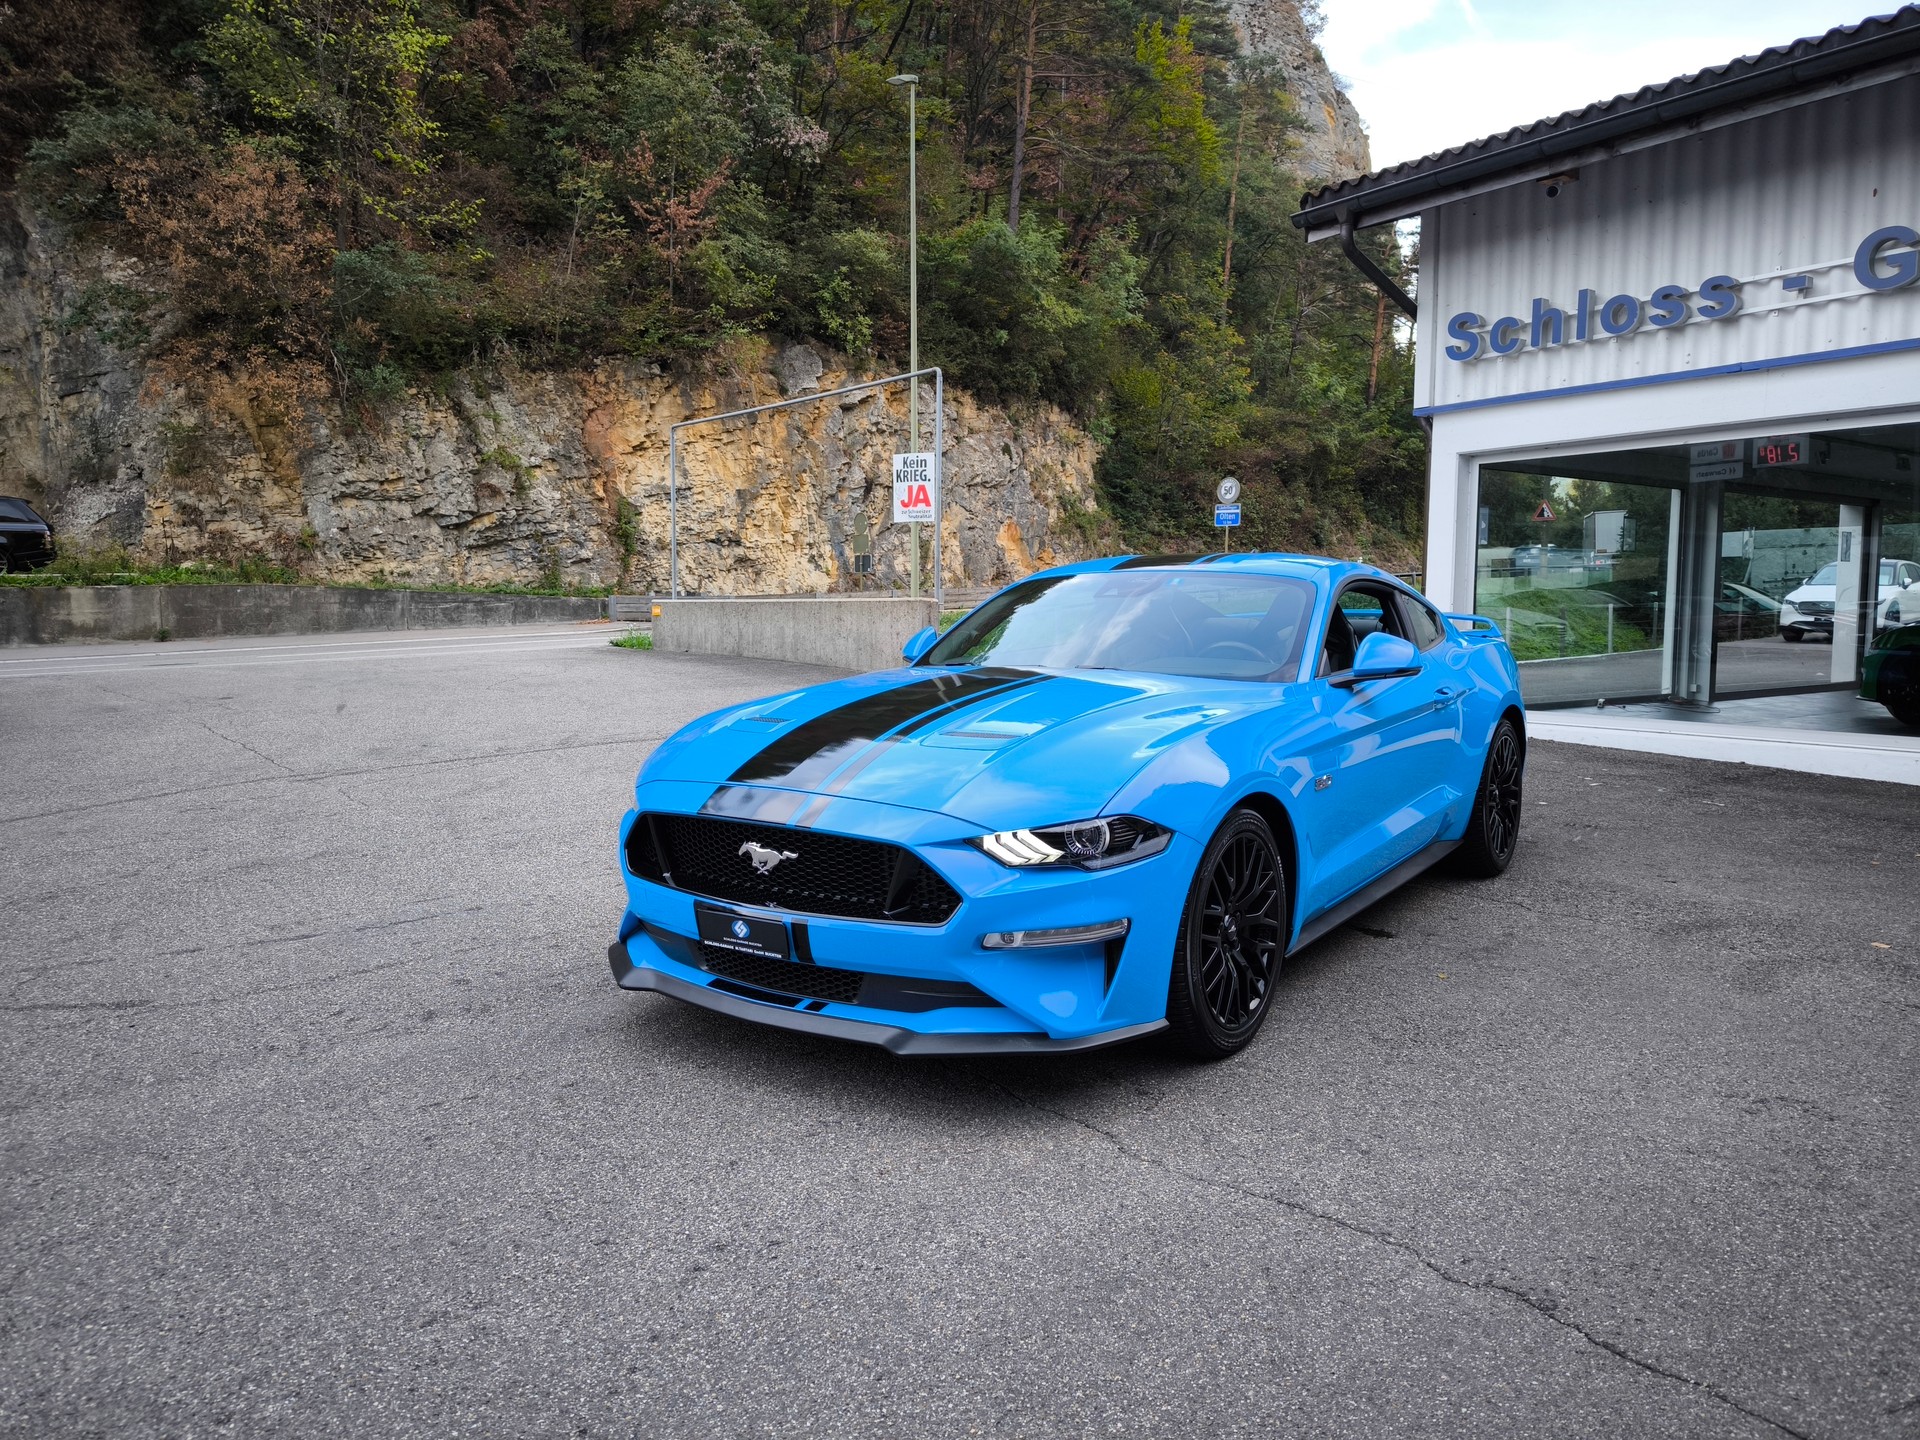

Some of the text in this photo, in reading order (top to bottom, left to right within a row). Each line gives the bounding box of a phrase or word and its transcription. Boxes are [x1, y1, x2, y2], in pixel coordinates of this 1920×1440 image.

[1444, 274, 1742, 363] Schloss
[902, 456, 927, 469] Kein
[896, 468, 930, 482] KRIEG.
[900, 484, 932, 508] JA
[1224, 486, 1232, 495] 50
